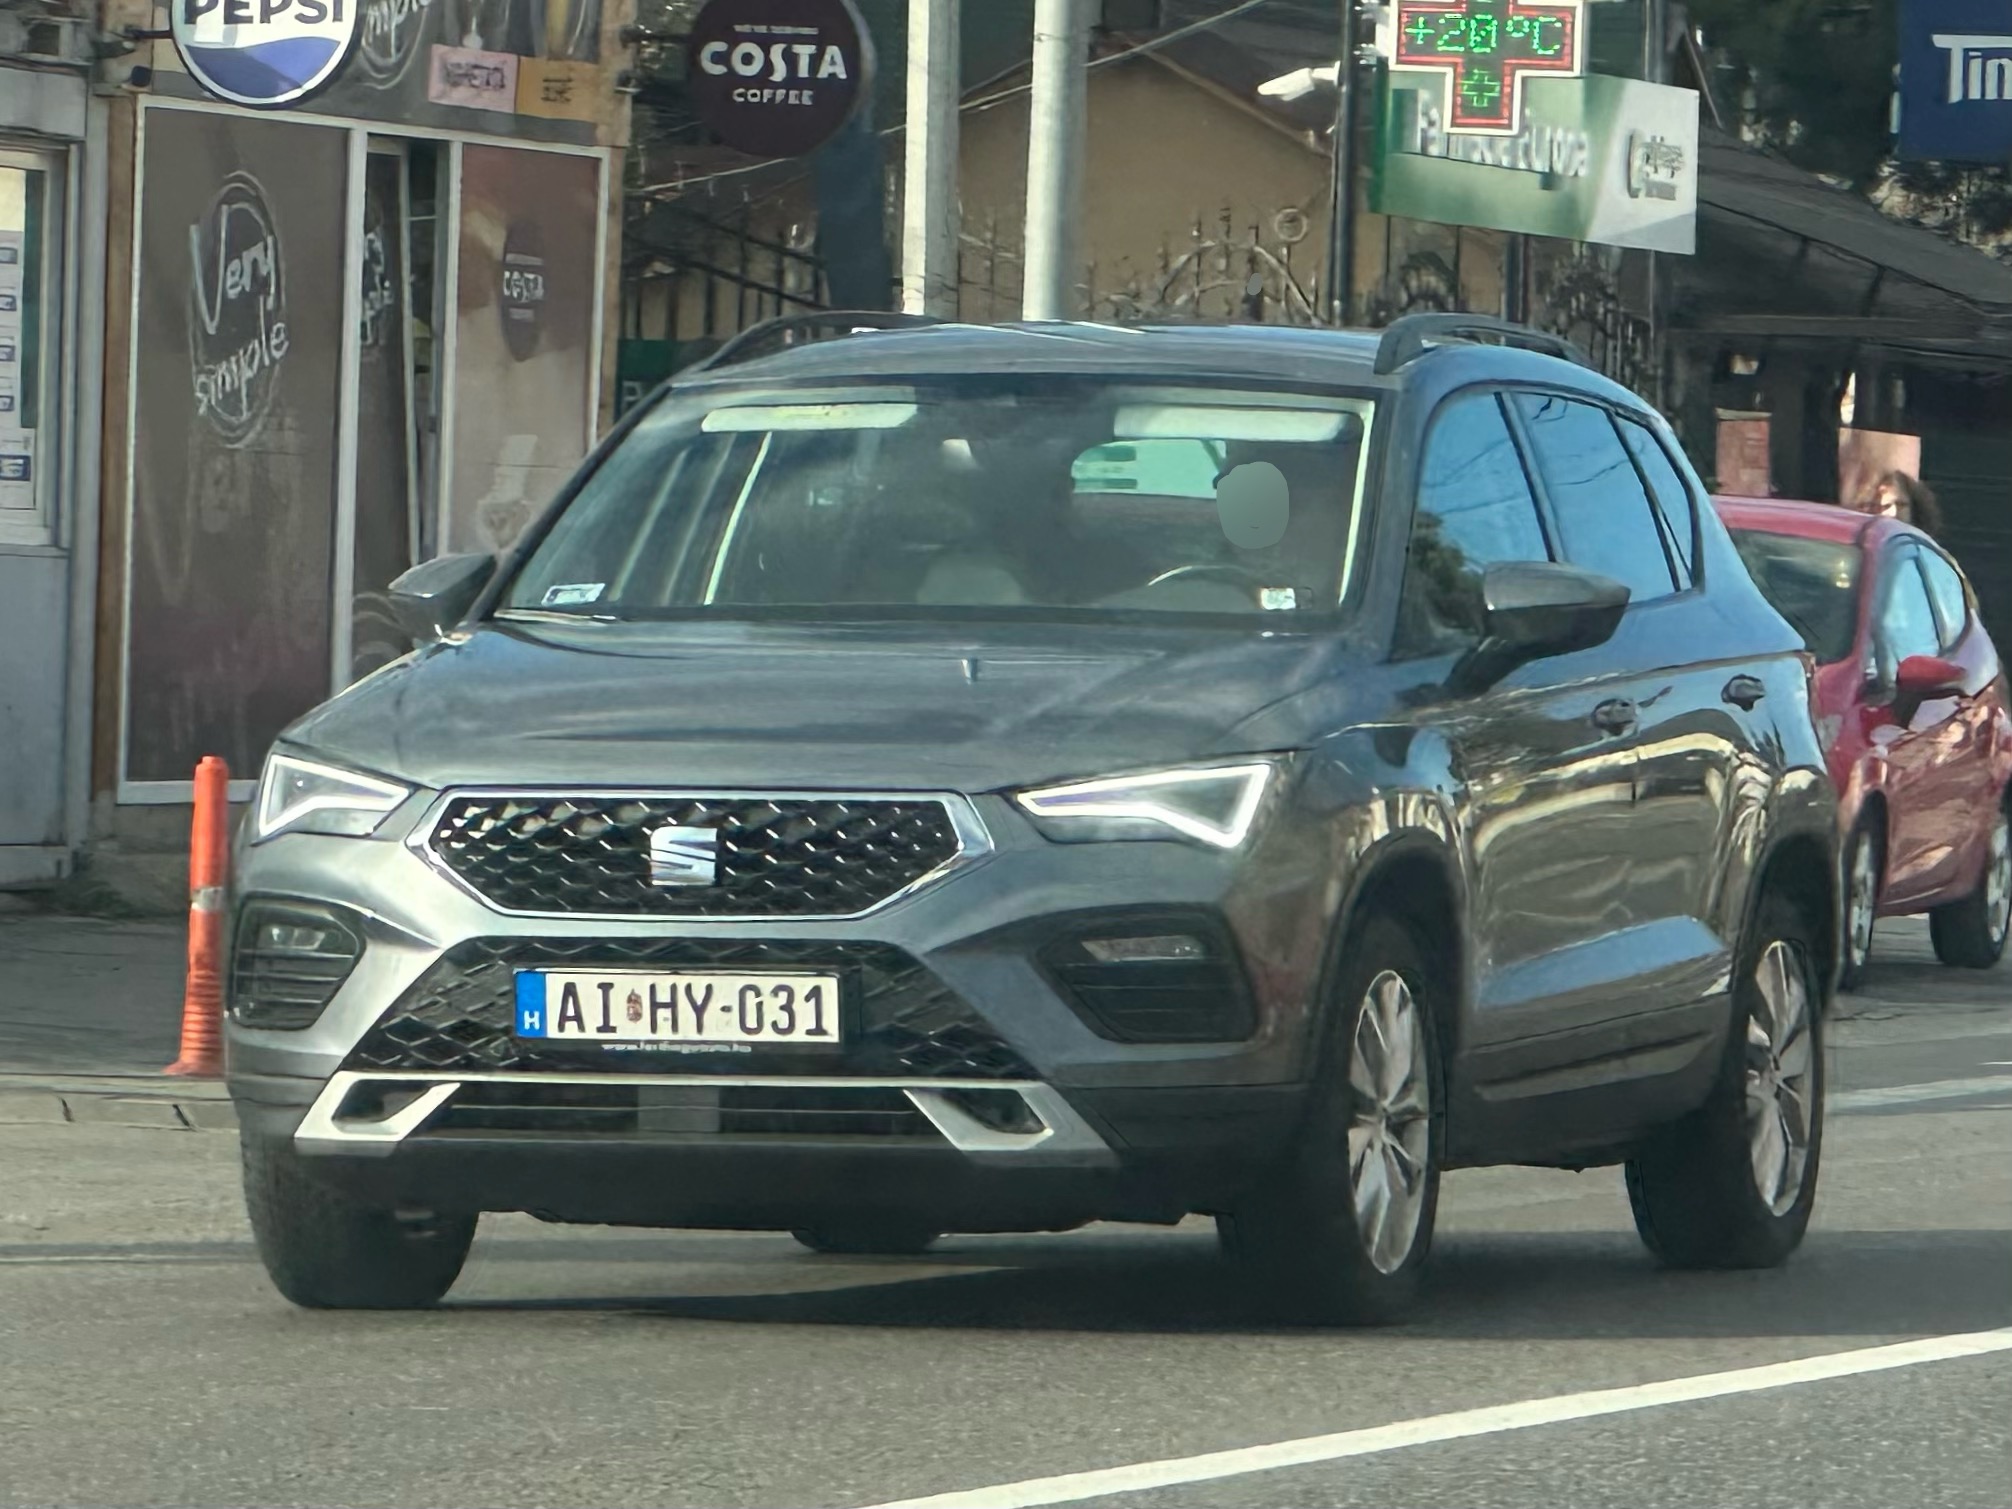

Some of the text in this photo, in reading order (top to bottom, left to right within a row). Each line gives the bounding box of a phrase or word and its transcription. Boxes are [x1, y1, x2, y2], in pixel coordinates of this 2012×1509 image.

[184, 0, 343, 25] PEPSI
[701, 41, 848, 82] COSTA
[733, 88, 814, 105] COFFEE
[523, 1010, 540, 1030] H
